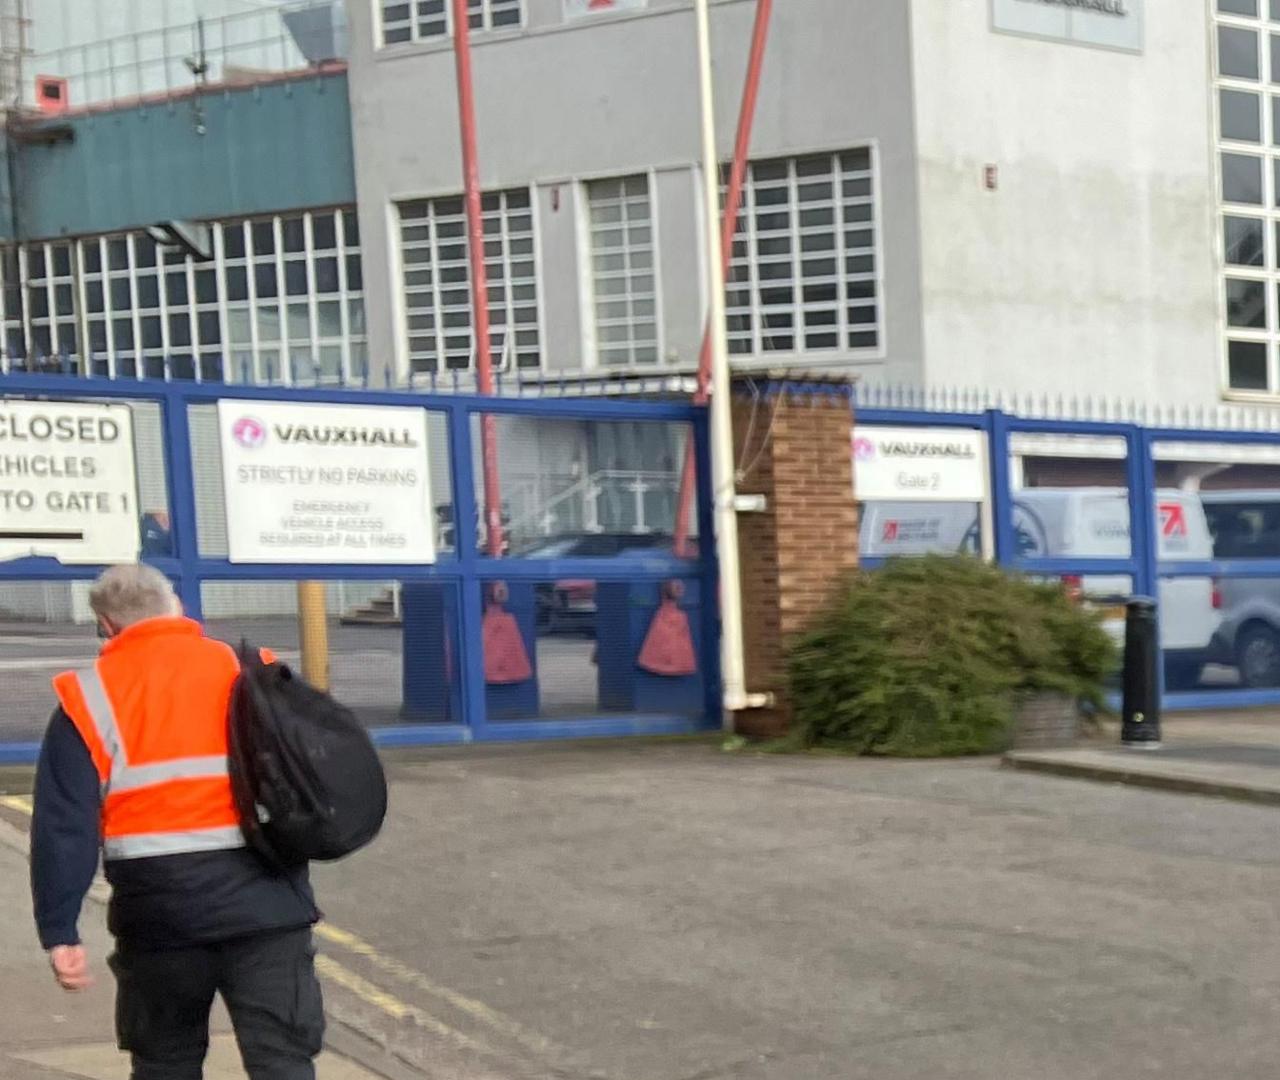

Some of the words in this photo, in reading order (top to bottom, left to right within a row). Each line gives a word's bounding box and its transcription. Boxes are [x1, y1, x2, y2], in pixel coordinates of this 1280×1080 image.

[274, 424, 418, 448] VAUXHALL
[880, 441, 976, 460] VAUXHALL
[0, 455, 97, 478] HICLES
[237, 464, 314, 486] STRICTLY
[319, 467, 343, 486] NO
[346, 467, 418, 488] PARKING
[46, 490, 111, 514] GATE
[120, 492, 129, 514] 1
